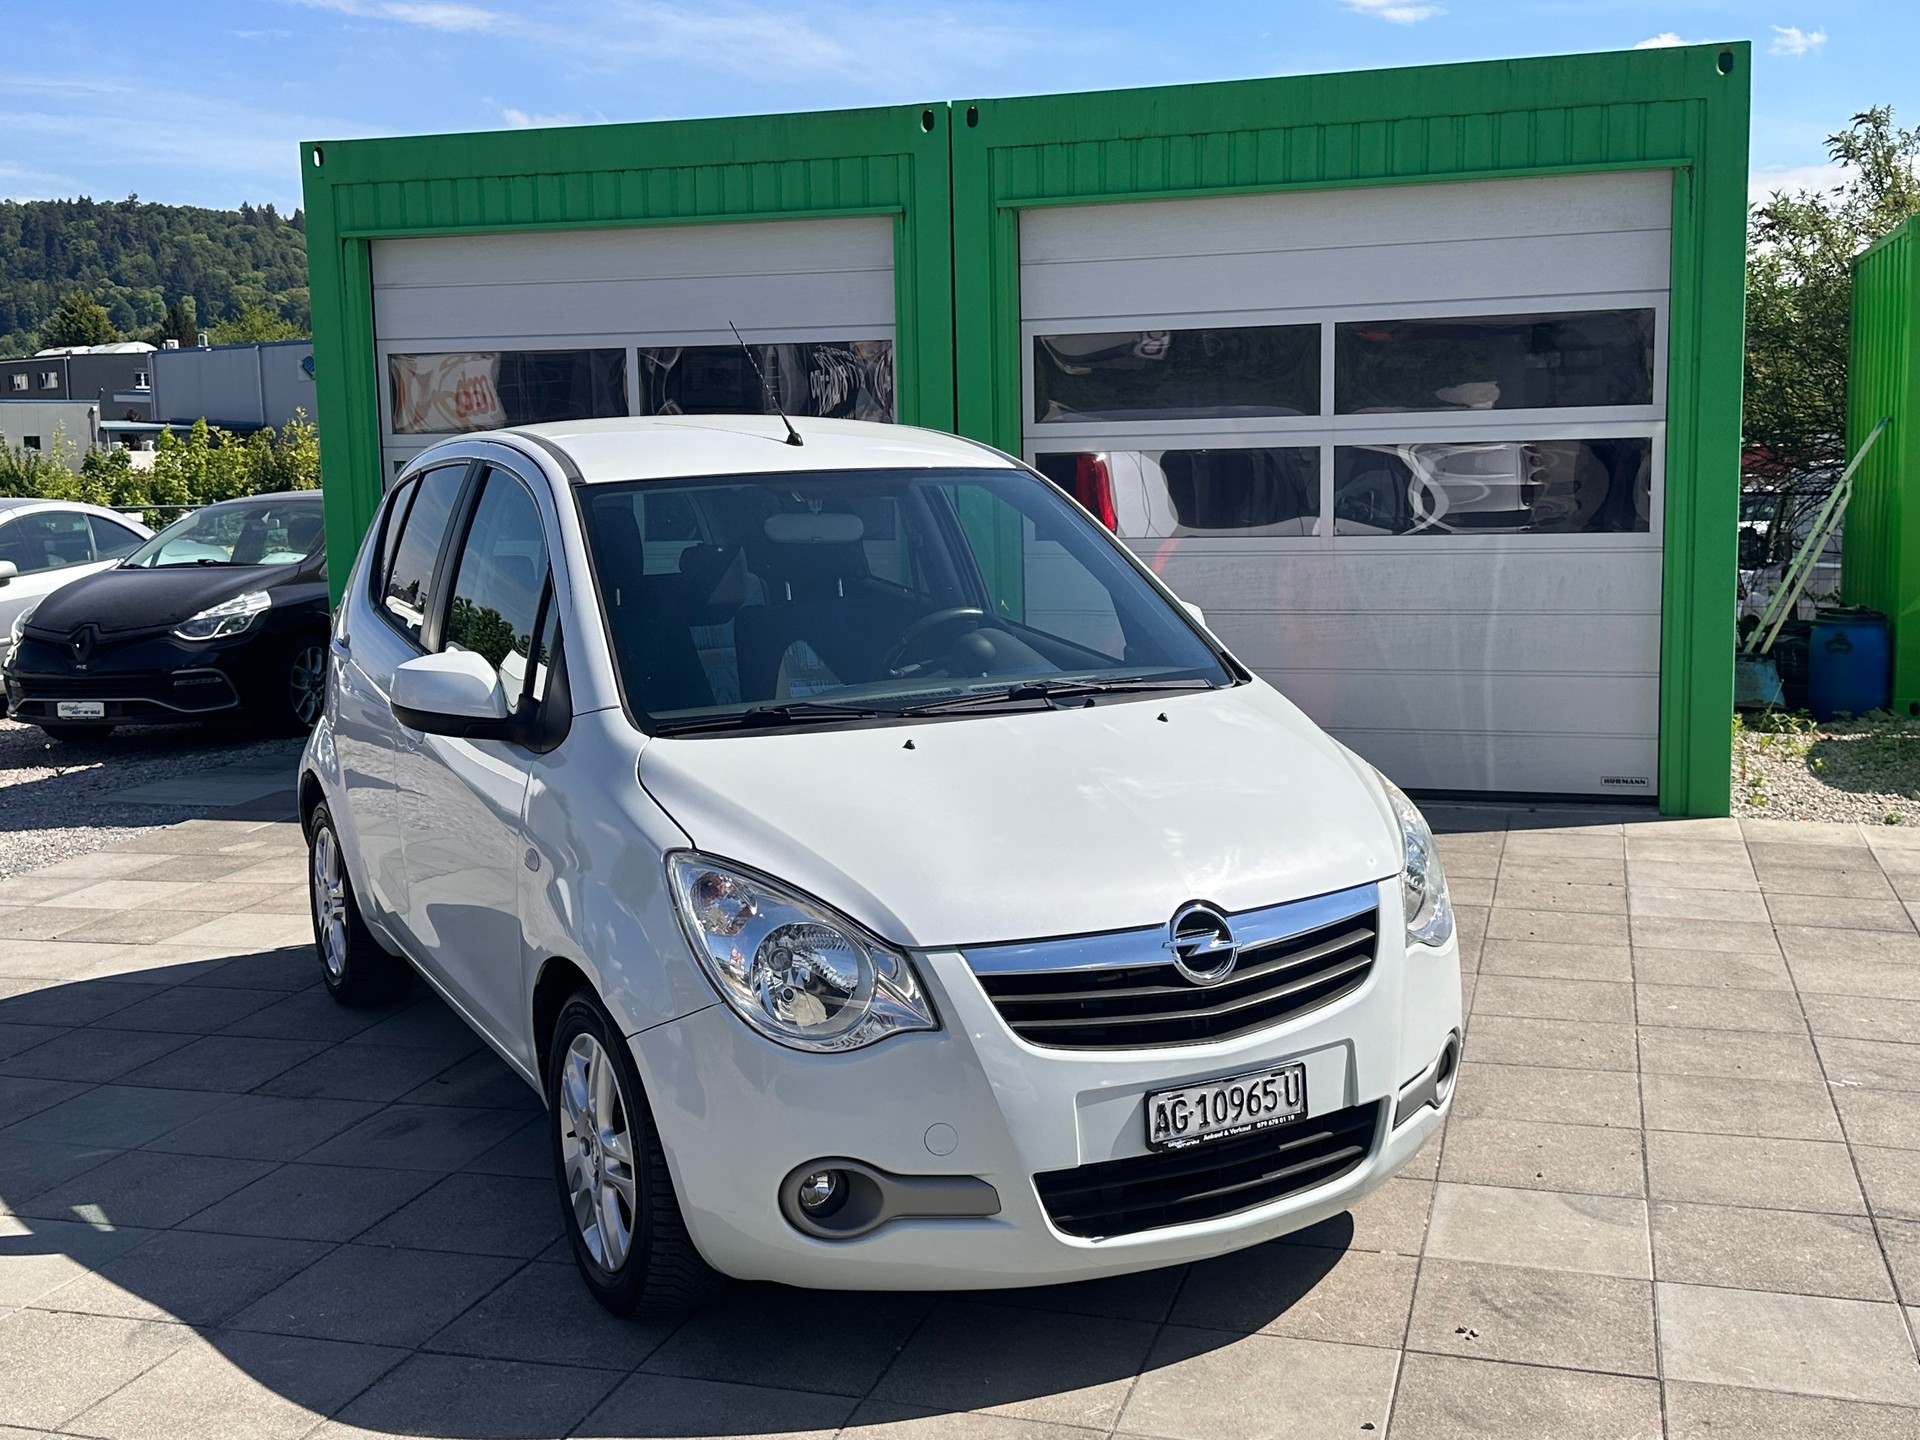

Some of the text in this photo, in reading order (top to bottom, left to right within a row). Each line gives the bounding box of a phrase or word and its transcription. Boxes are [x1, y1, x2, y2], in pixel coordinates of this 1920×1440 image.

[1203, 1130, 1223, 1141] Ankauf
[1229, 1124, 1252, 1135] Verkauf
[1256, 1120, 1268, 1129] 079
